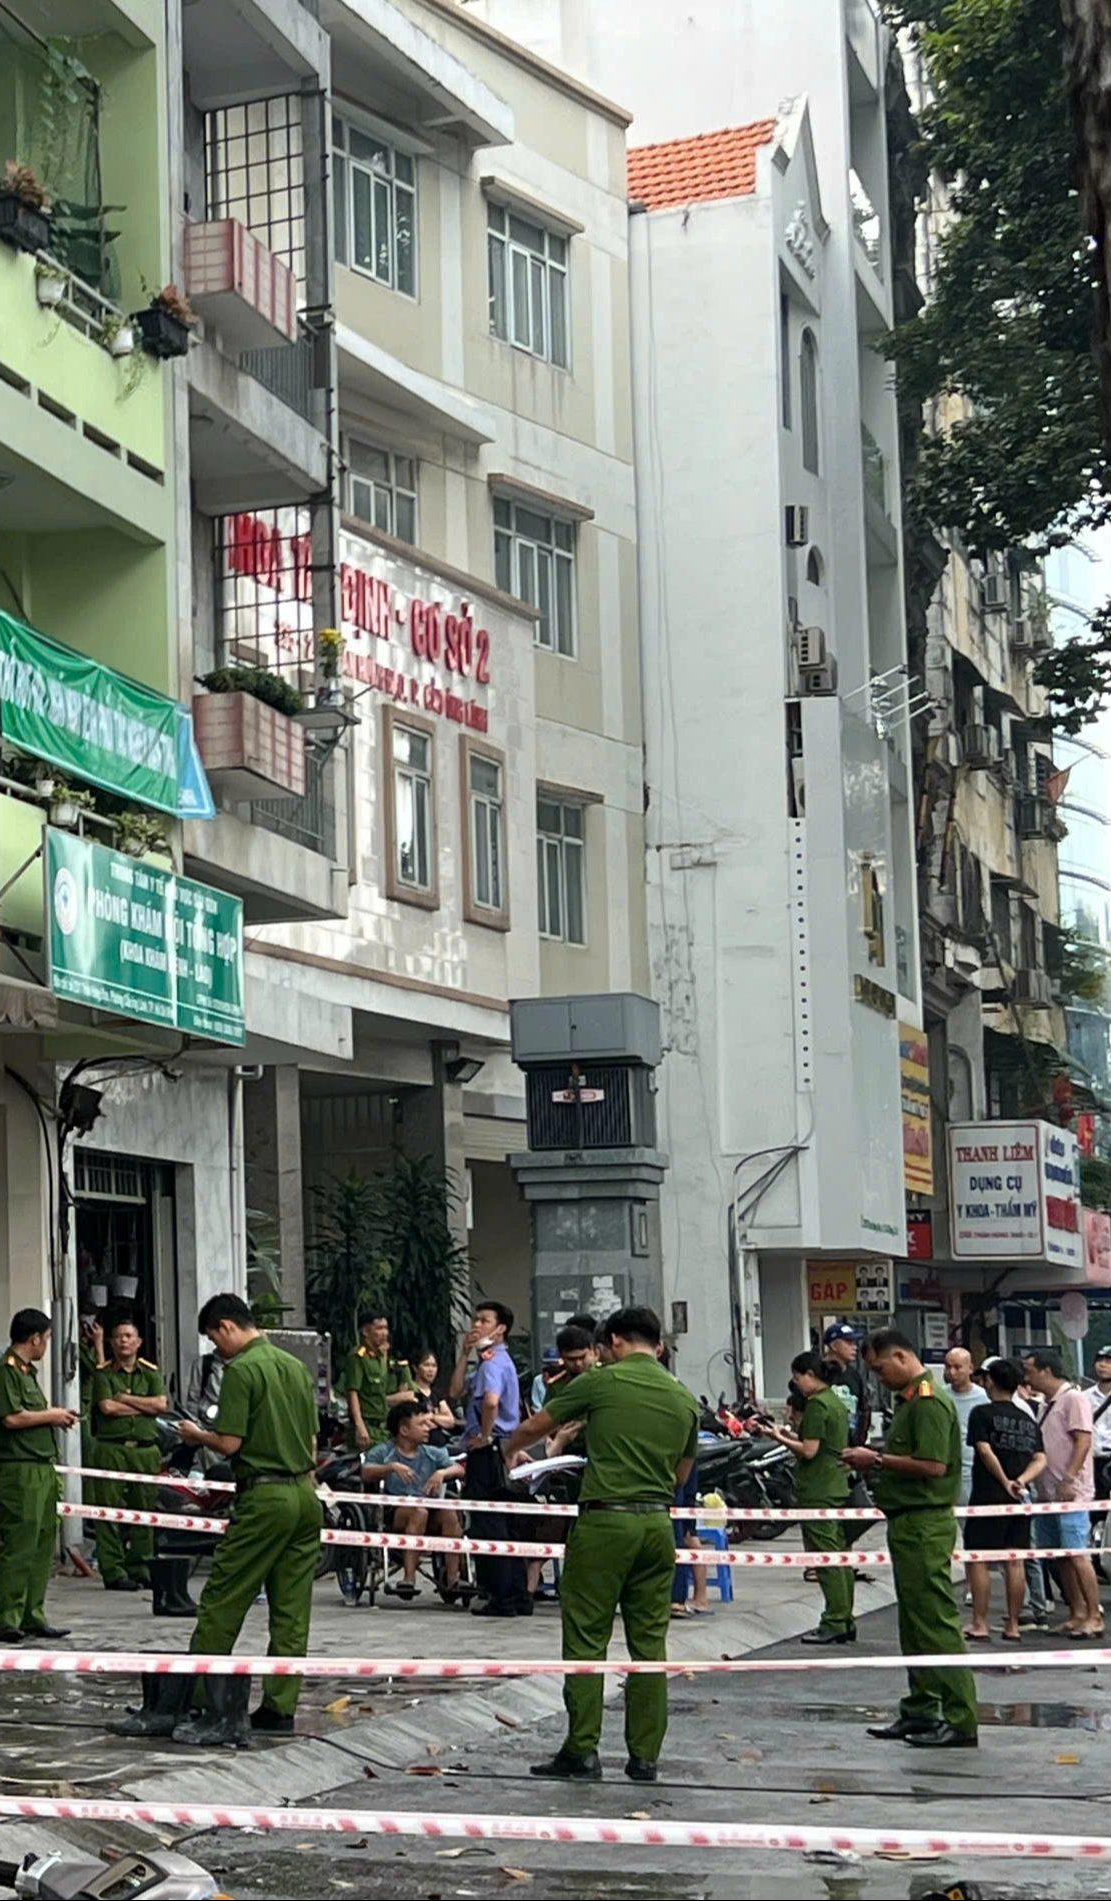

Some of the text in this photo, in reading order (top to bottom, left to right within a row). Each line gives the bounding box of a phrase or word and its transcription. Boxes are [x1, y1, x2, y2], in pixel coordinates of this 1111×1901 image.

[476, 628, 490, 685] 2
[130, 901, 163, 938] KHÁM
[956, 1146, 999, 1163] THANH
[969, 1175, 1022, 1194] DỤNG CỤ
